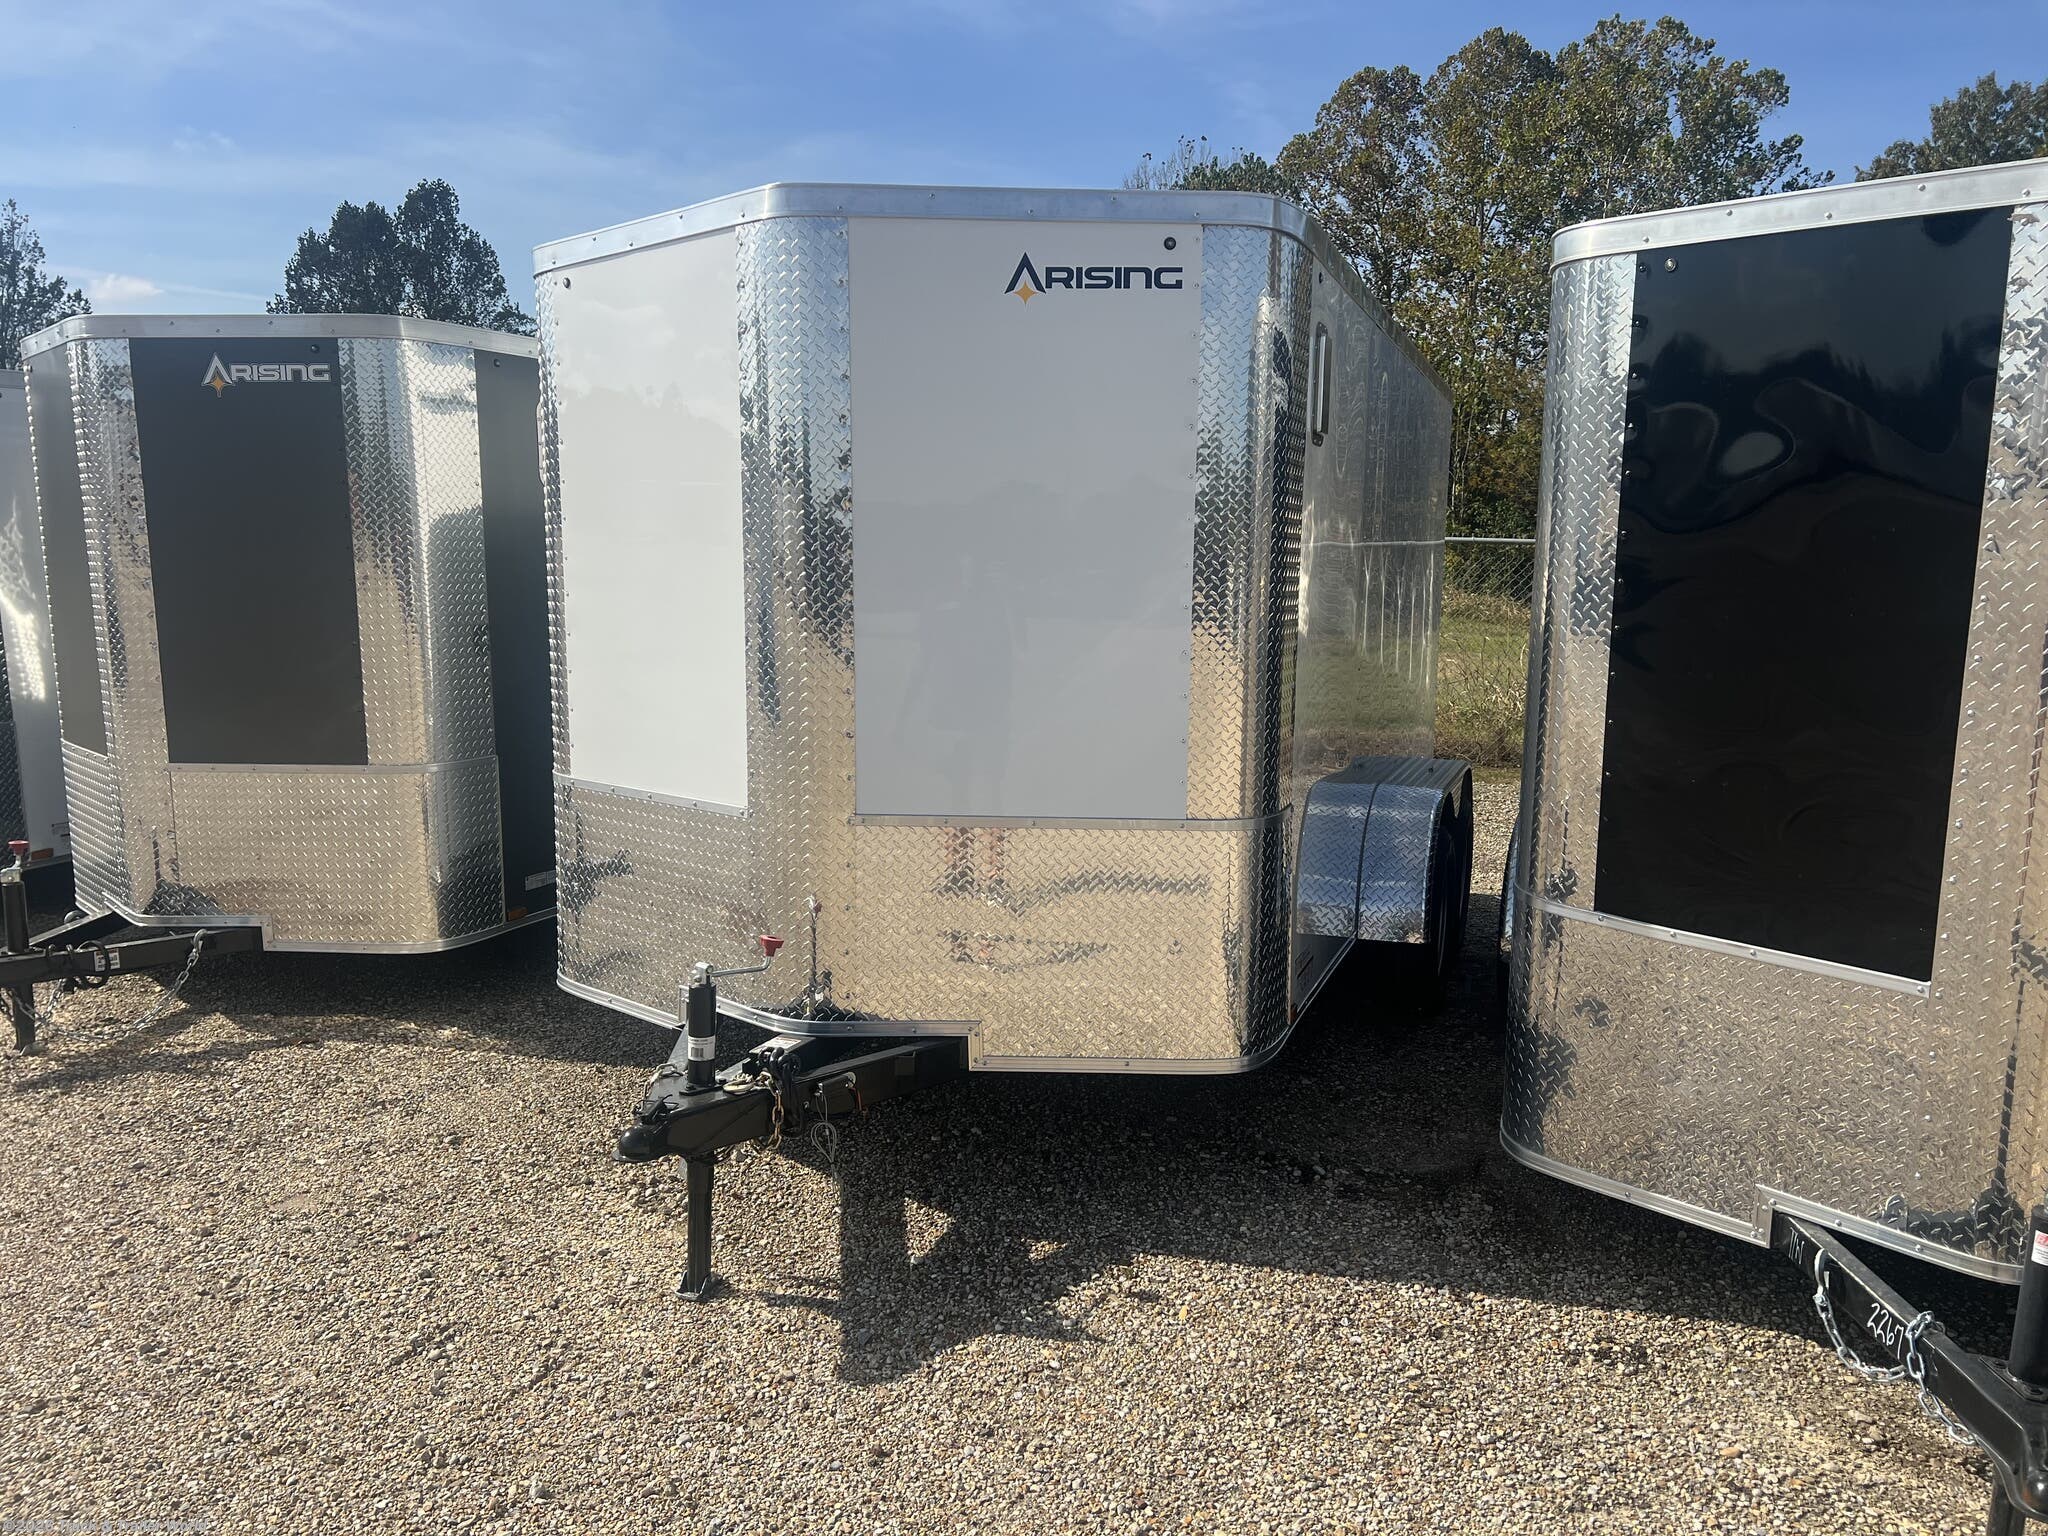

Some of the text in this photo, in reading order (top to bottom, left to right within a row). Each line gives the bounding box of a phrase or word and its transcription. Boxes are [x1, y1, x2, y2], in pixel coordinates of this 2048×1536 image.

[1004, 252, 1184, 296] ARISING
[202, 353, 331, 387] ARISING
[1867, 1302, 1904, 1360] 2267
